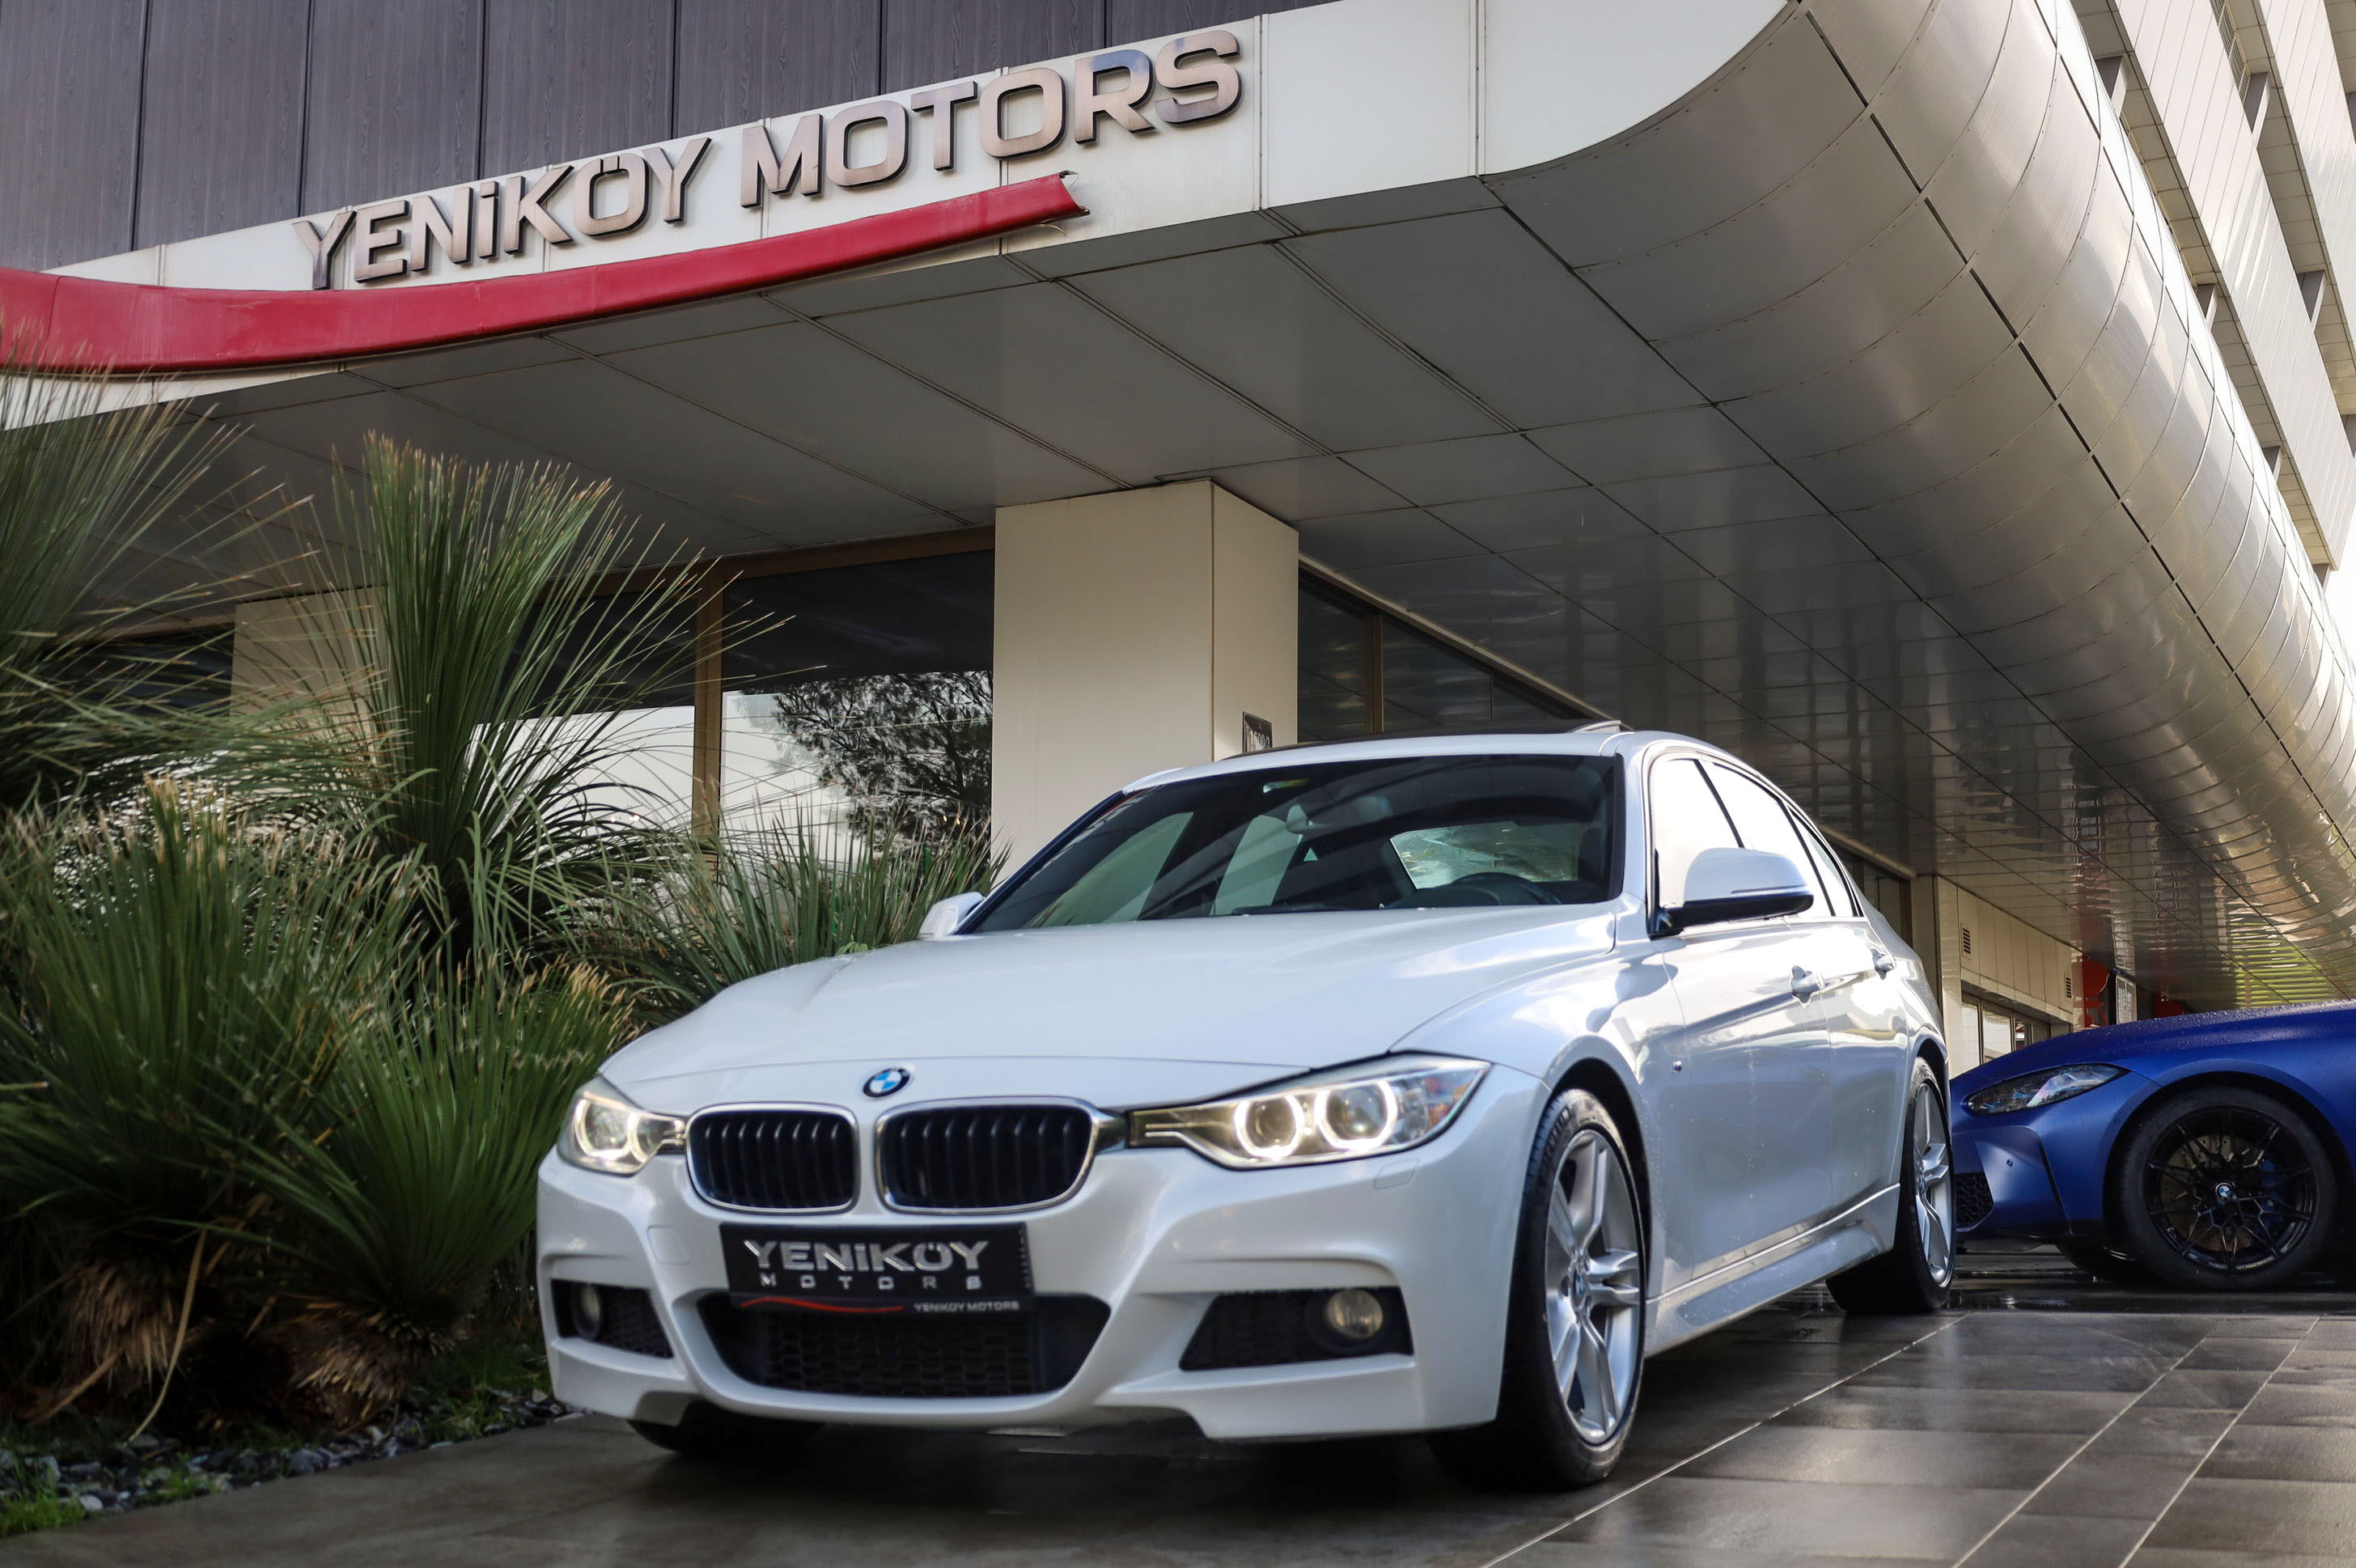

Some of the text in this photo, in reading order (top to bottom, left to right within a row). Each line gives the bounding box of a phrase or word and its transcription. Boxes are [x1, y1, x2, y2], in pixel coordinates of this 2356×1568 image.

[740, 29, 1242, 208] MOTORS
[760, 1273, 982, 1290] MOTORS
[966, 1300, 1019, 1312] MOTORS
